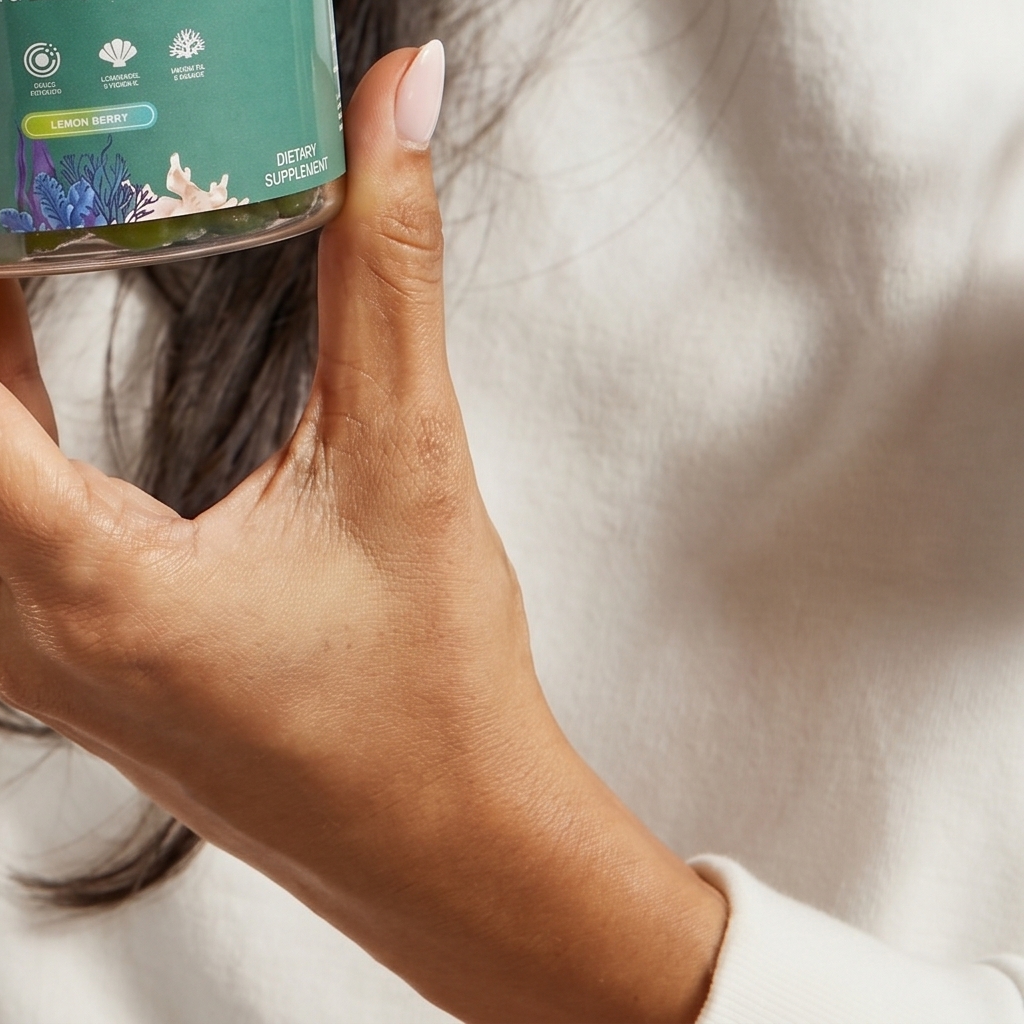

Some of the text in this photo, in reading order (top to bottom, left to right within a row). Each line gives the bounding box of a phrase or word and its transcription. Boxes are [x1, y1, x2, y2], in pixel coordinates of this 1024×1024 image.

[51, 114, 128, 129] LEMON BERRY
[276, 143, 317, 166] DIETARY
